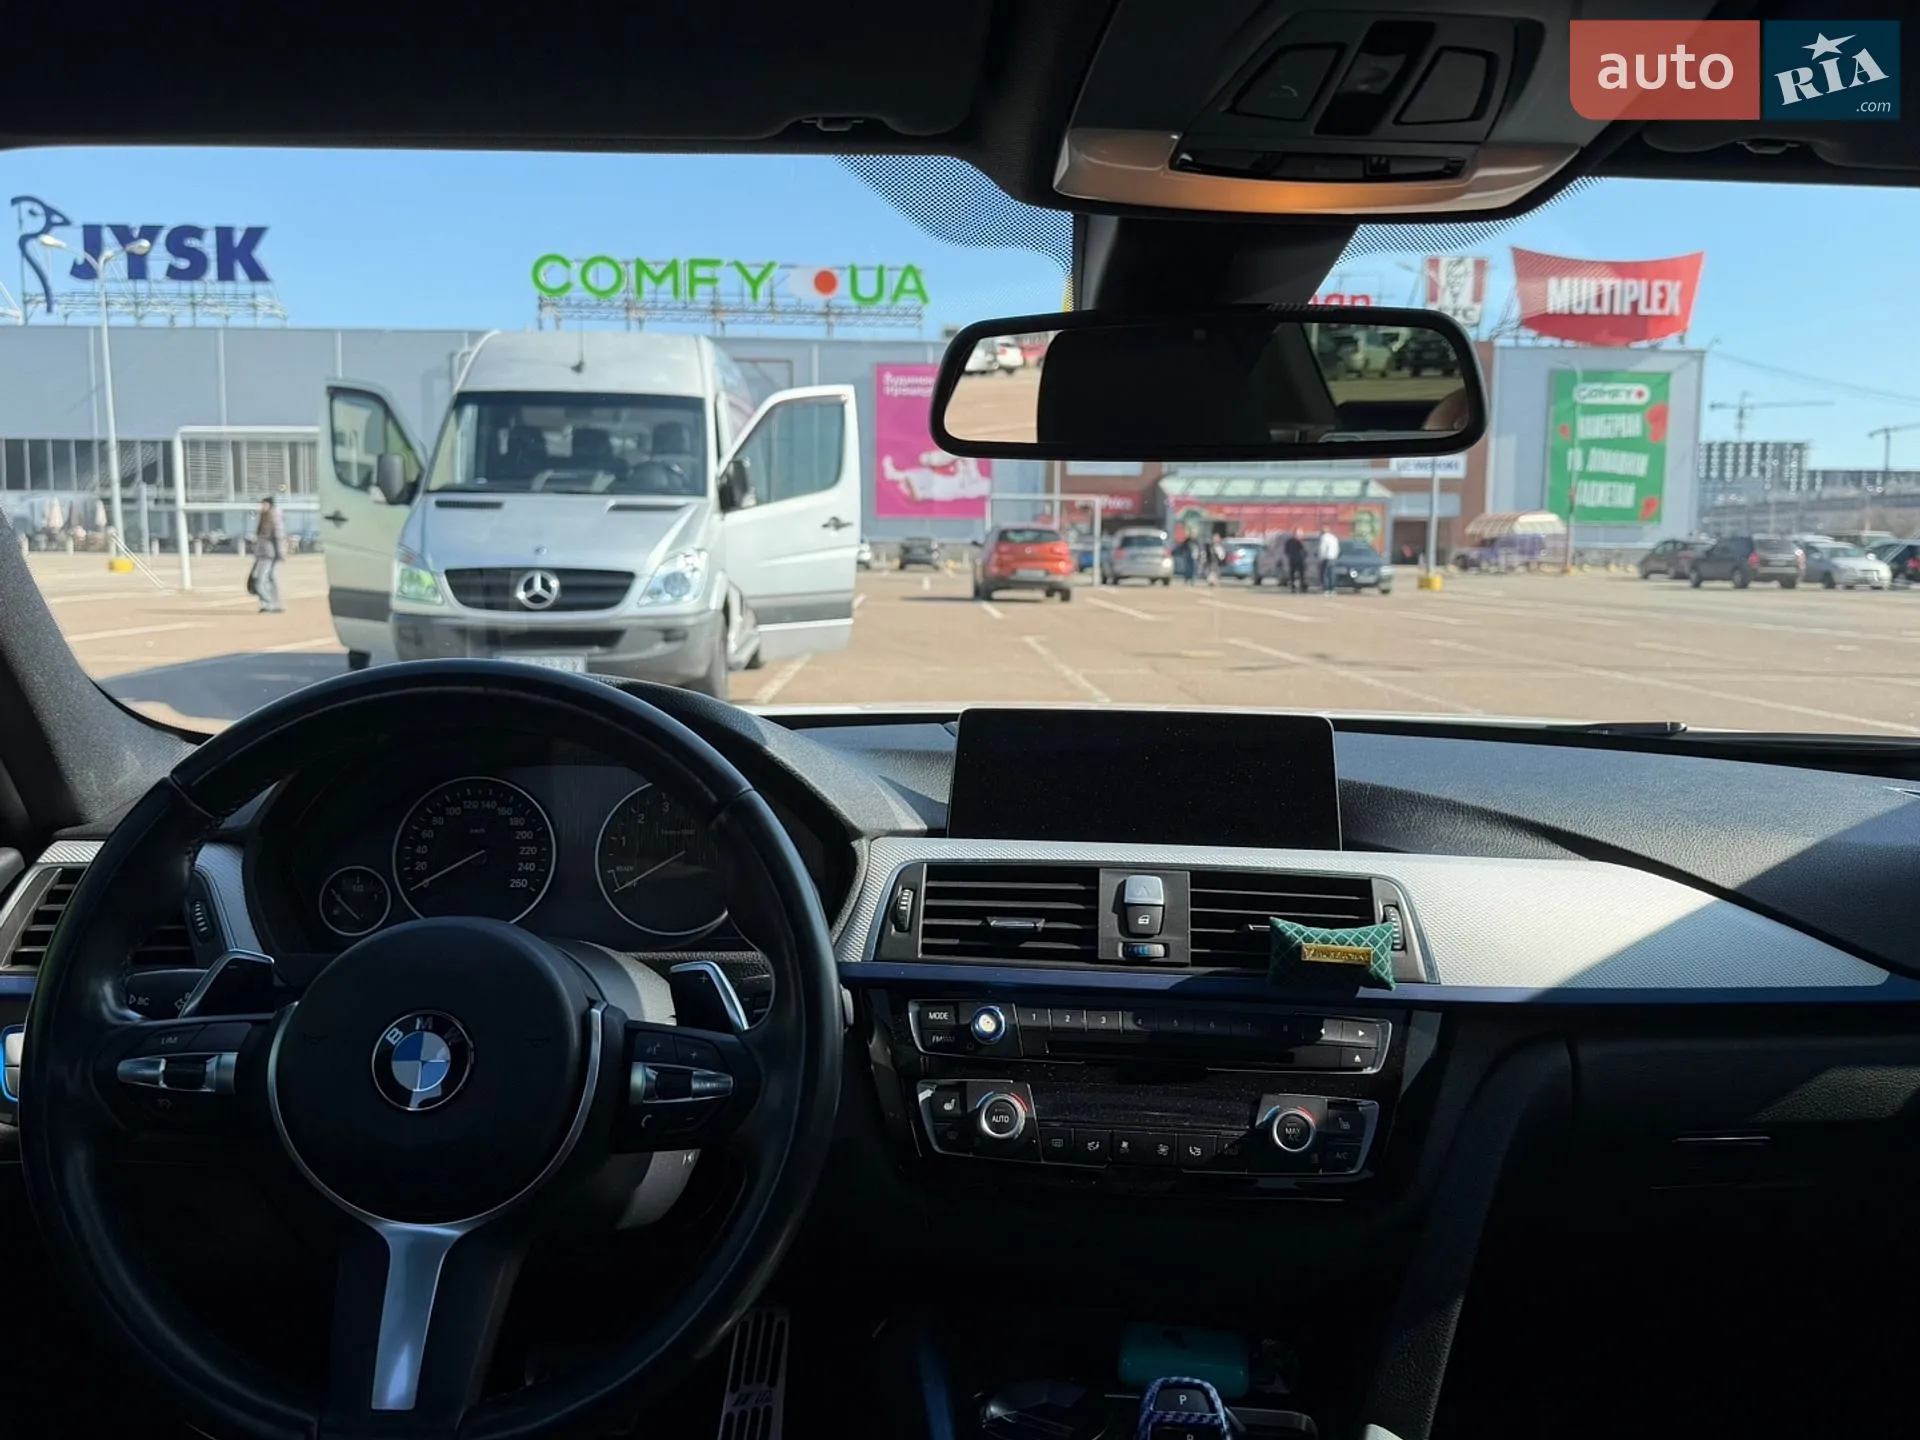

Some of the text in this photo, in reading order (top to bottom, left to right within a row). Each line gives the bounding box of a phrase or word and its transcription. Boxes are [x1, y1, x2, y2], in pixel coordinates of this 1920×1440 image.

[70, 224, 270, 282] JYSK
[531, 254, 930, 304] COMFY UA
[1547, 276, 1682, 316] MULTIPLEX
[1577, 386, 1633, 400] COMFY
[462, 800, 479, 810] 120
[480, 800, 497, 810] 140
[445, 806, 462, 817] 100
[637, 813, 646, 824] 2
[420, 829, 434, 840] 60
[515, 830, 534, 840] 200
[415, 844, 428, 855] 40
[519, 845, 538, 856] 220
[415, 861, 428, 872] 20
[517, 862, 536, 873] 240
[509, 878, 528, 889] 260
[928, 1011, 949, 1020] MODE
[991, 1114, 1010, 1124] AUTO
[1285, 1127, 1301, 1135] MAX
